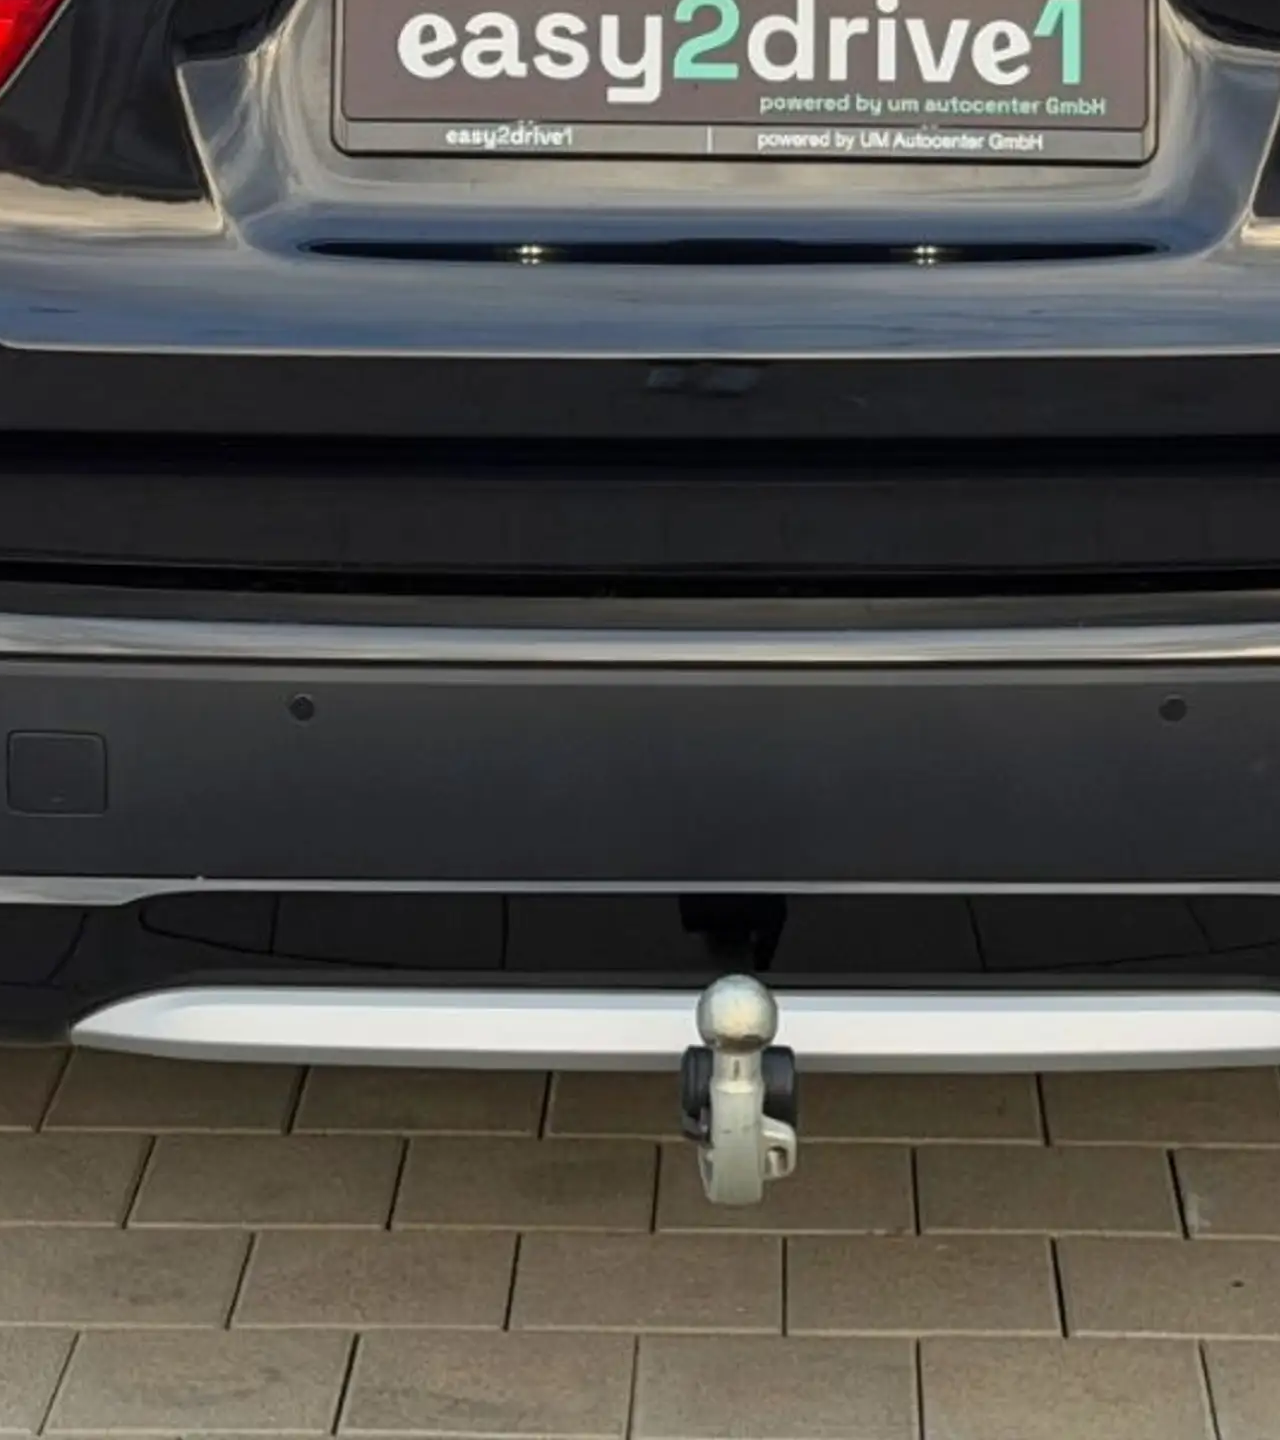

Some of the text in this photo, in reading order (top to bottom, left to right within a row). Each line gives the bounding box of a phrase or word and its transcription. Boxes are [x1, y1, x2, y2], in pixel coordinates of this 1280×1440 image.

[759, 93, 1106, 117] powered by um autocenter GmbH
[445, 124, 573, 150] easy2drive1
[757, 132, 1044, 152] powered by UM Autocenter GmbH
